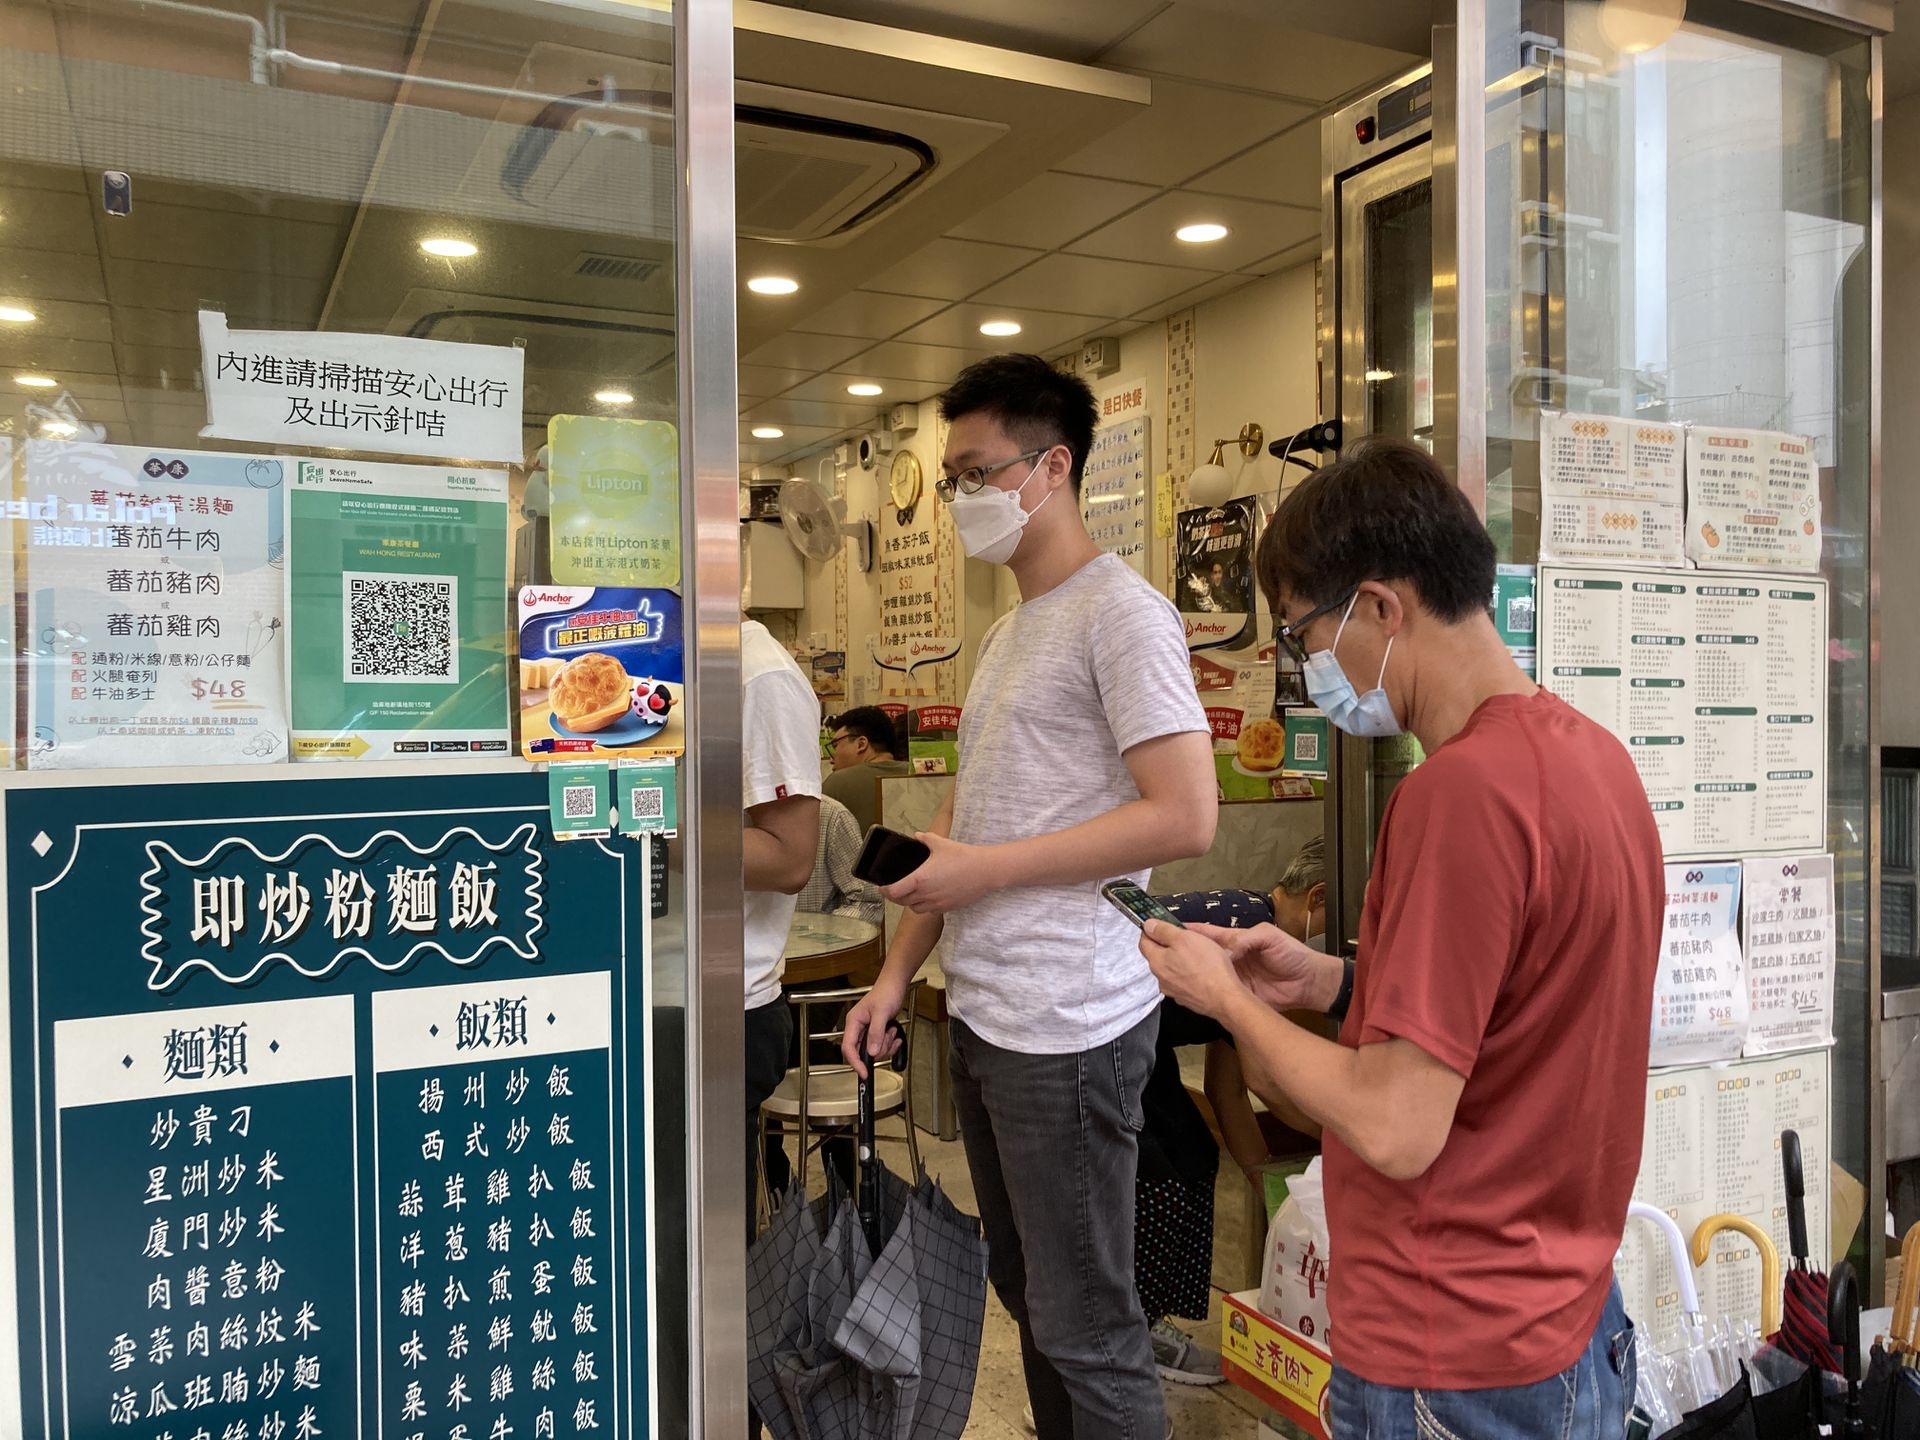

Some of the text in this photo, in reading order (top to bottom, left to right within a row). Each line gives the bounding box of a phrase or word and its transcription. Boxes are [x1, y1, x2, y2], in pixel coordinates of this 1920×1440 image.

[283, 395, 447, 438] 及出示針咭
[1102, 387, 1143, 417] 是日快餐
[329, 468, 357, 478] 安心出行
[329, 477, 373, 485] LeaveHomeSafe
[586, 474, 643, 492] Lipton
[107, 525, 220, 551] 蕃茄牛肉
[107, 569, 221, 595] 蕃茄豬肉
[898, 575, 913, 590] $52
[538, 592, 573, 603] Anchor
[107, 613, 221, 638] 蕃茄雞肉
[557, 621, 648, 647] 最正嘅菠蘿油
[1195, 622, 1227, 633] Anchor
[71, 651, 87, 666] 配
[921, 643, 946, 653] Anchor
[71, 669, 158, 684] 配 火腿奄列
[190, 677, 247, 699] $48
[71, 687, 155, 701] 配 牛油多士
[922, 715, 958, 728] 安佳牛油
[189, 859, 500, 949] 即炒粉麵飯
[1708, 1006, 1732, 1020] $48
[1791, 989, 1818, 1009] $45
[454, 994, 529, 1052] 飯類
[163, 1020, 249, 1085] 麵類
[418, 1064, 574, 1114] 揚州炒飯
[149, 1103, 252, 1151] 炒貴刁
[421, 1112, 575, 1162] 西式炒飯
[143, 1149, 285, 1205] 星洲炒米
[398, 1158, 596, 1218] 蒜茸雞扒飯
[141, 1201, 286, 1259] 廈門炒米
[147, 1255, 286, 1310] 肉醬意粉
[399, 1254, 598, 1318] 豬扒煎蛋飯
[108, 1300, 321, 1372] 雪菜肉絲炆米
[399, 1302, 598, 1370] 味菜鮮魷飯
[1254, 1339, 1314, 1388] 五香肉丁
[110, 1354, 321, 1426] 涼瓜班腩炒麵
[400, 1349, 599, 1422] 粟米雞絲飯
[404, 1397, 600, 1440] 牛肉飯
